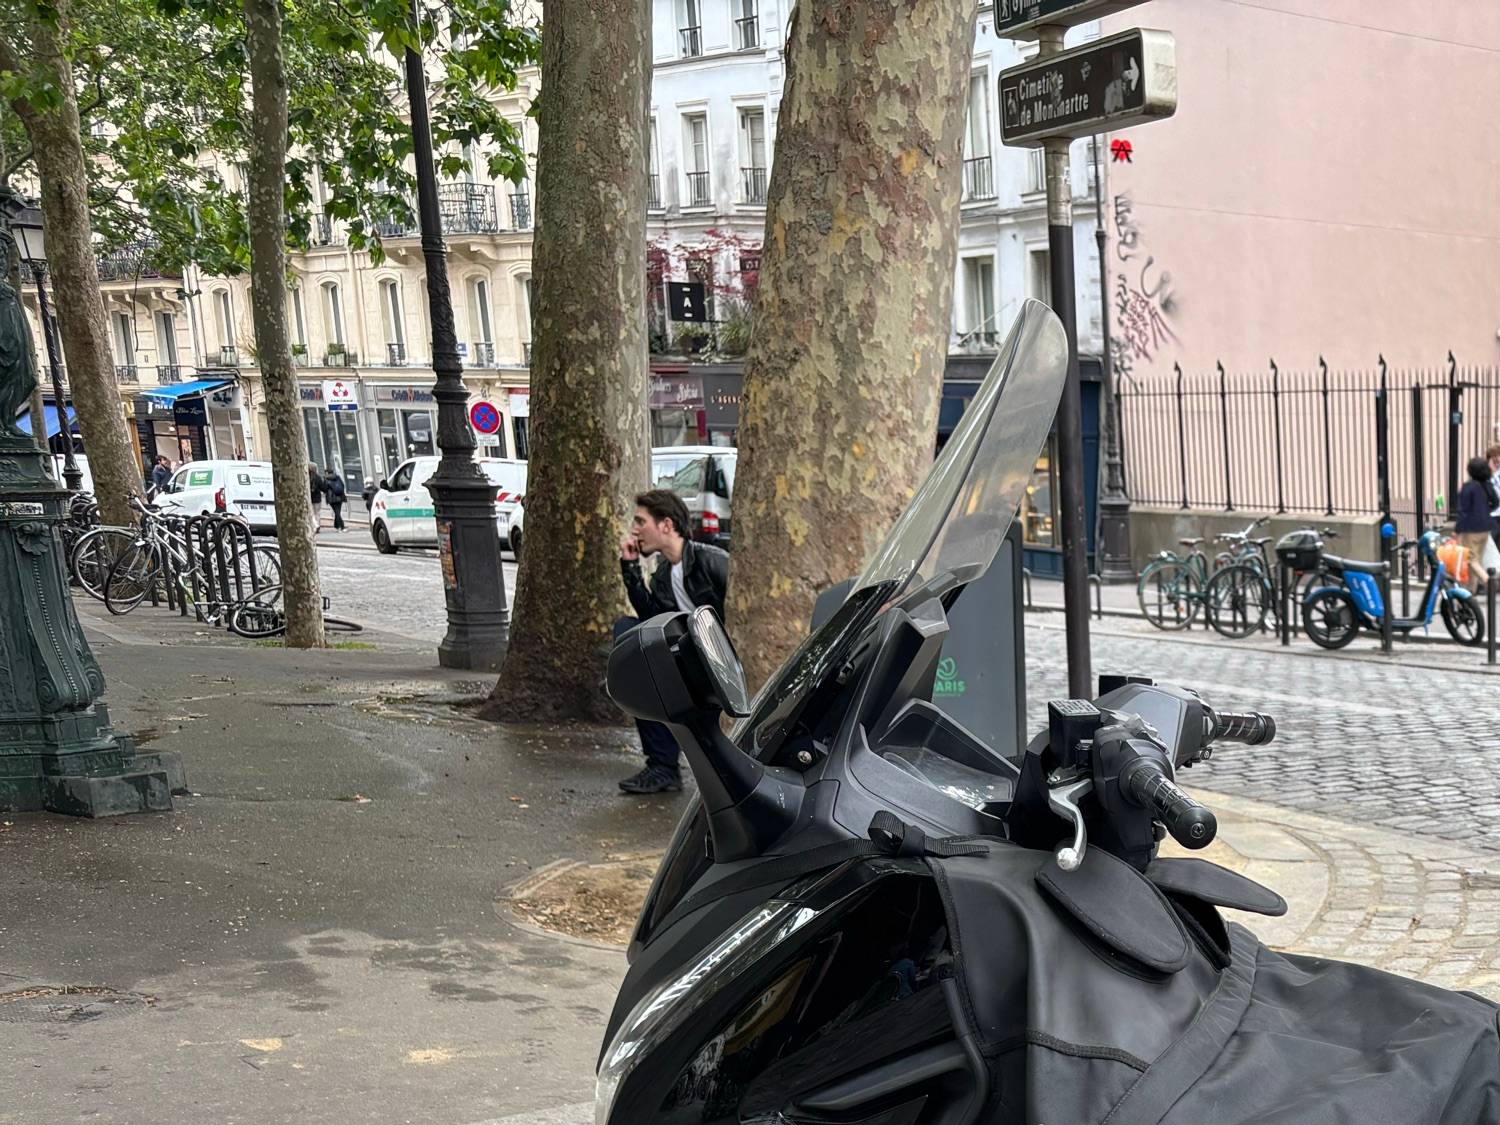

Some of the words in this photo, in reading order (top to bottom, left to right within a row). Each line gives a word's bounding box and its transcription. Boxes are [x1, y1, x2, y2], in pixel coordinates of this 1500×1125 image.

[1019, 71, 1064, 100] Cimetie
[1020, 104, 1032, 126] de
[934, 680, 966, 692] ARIS
